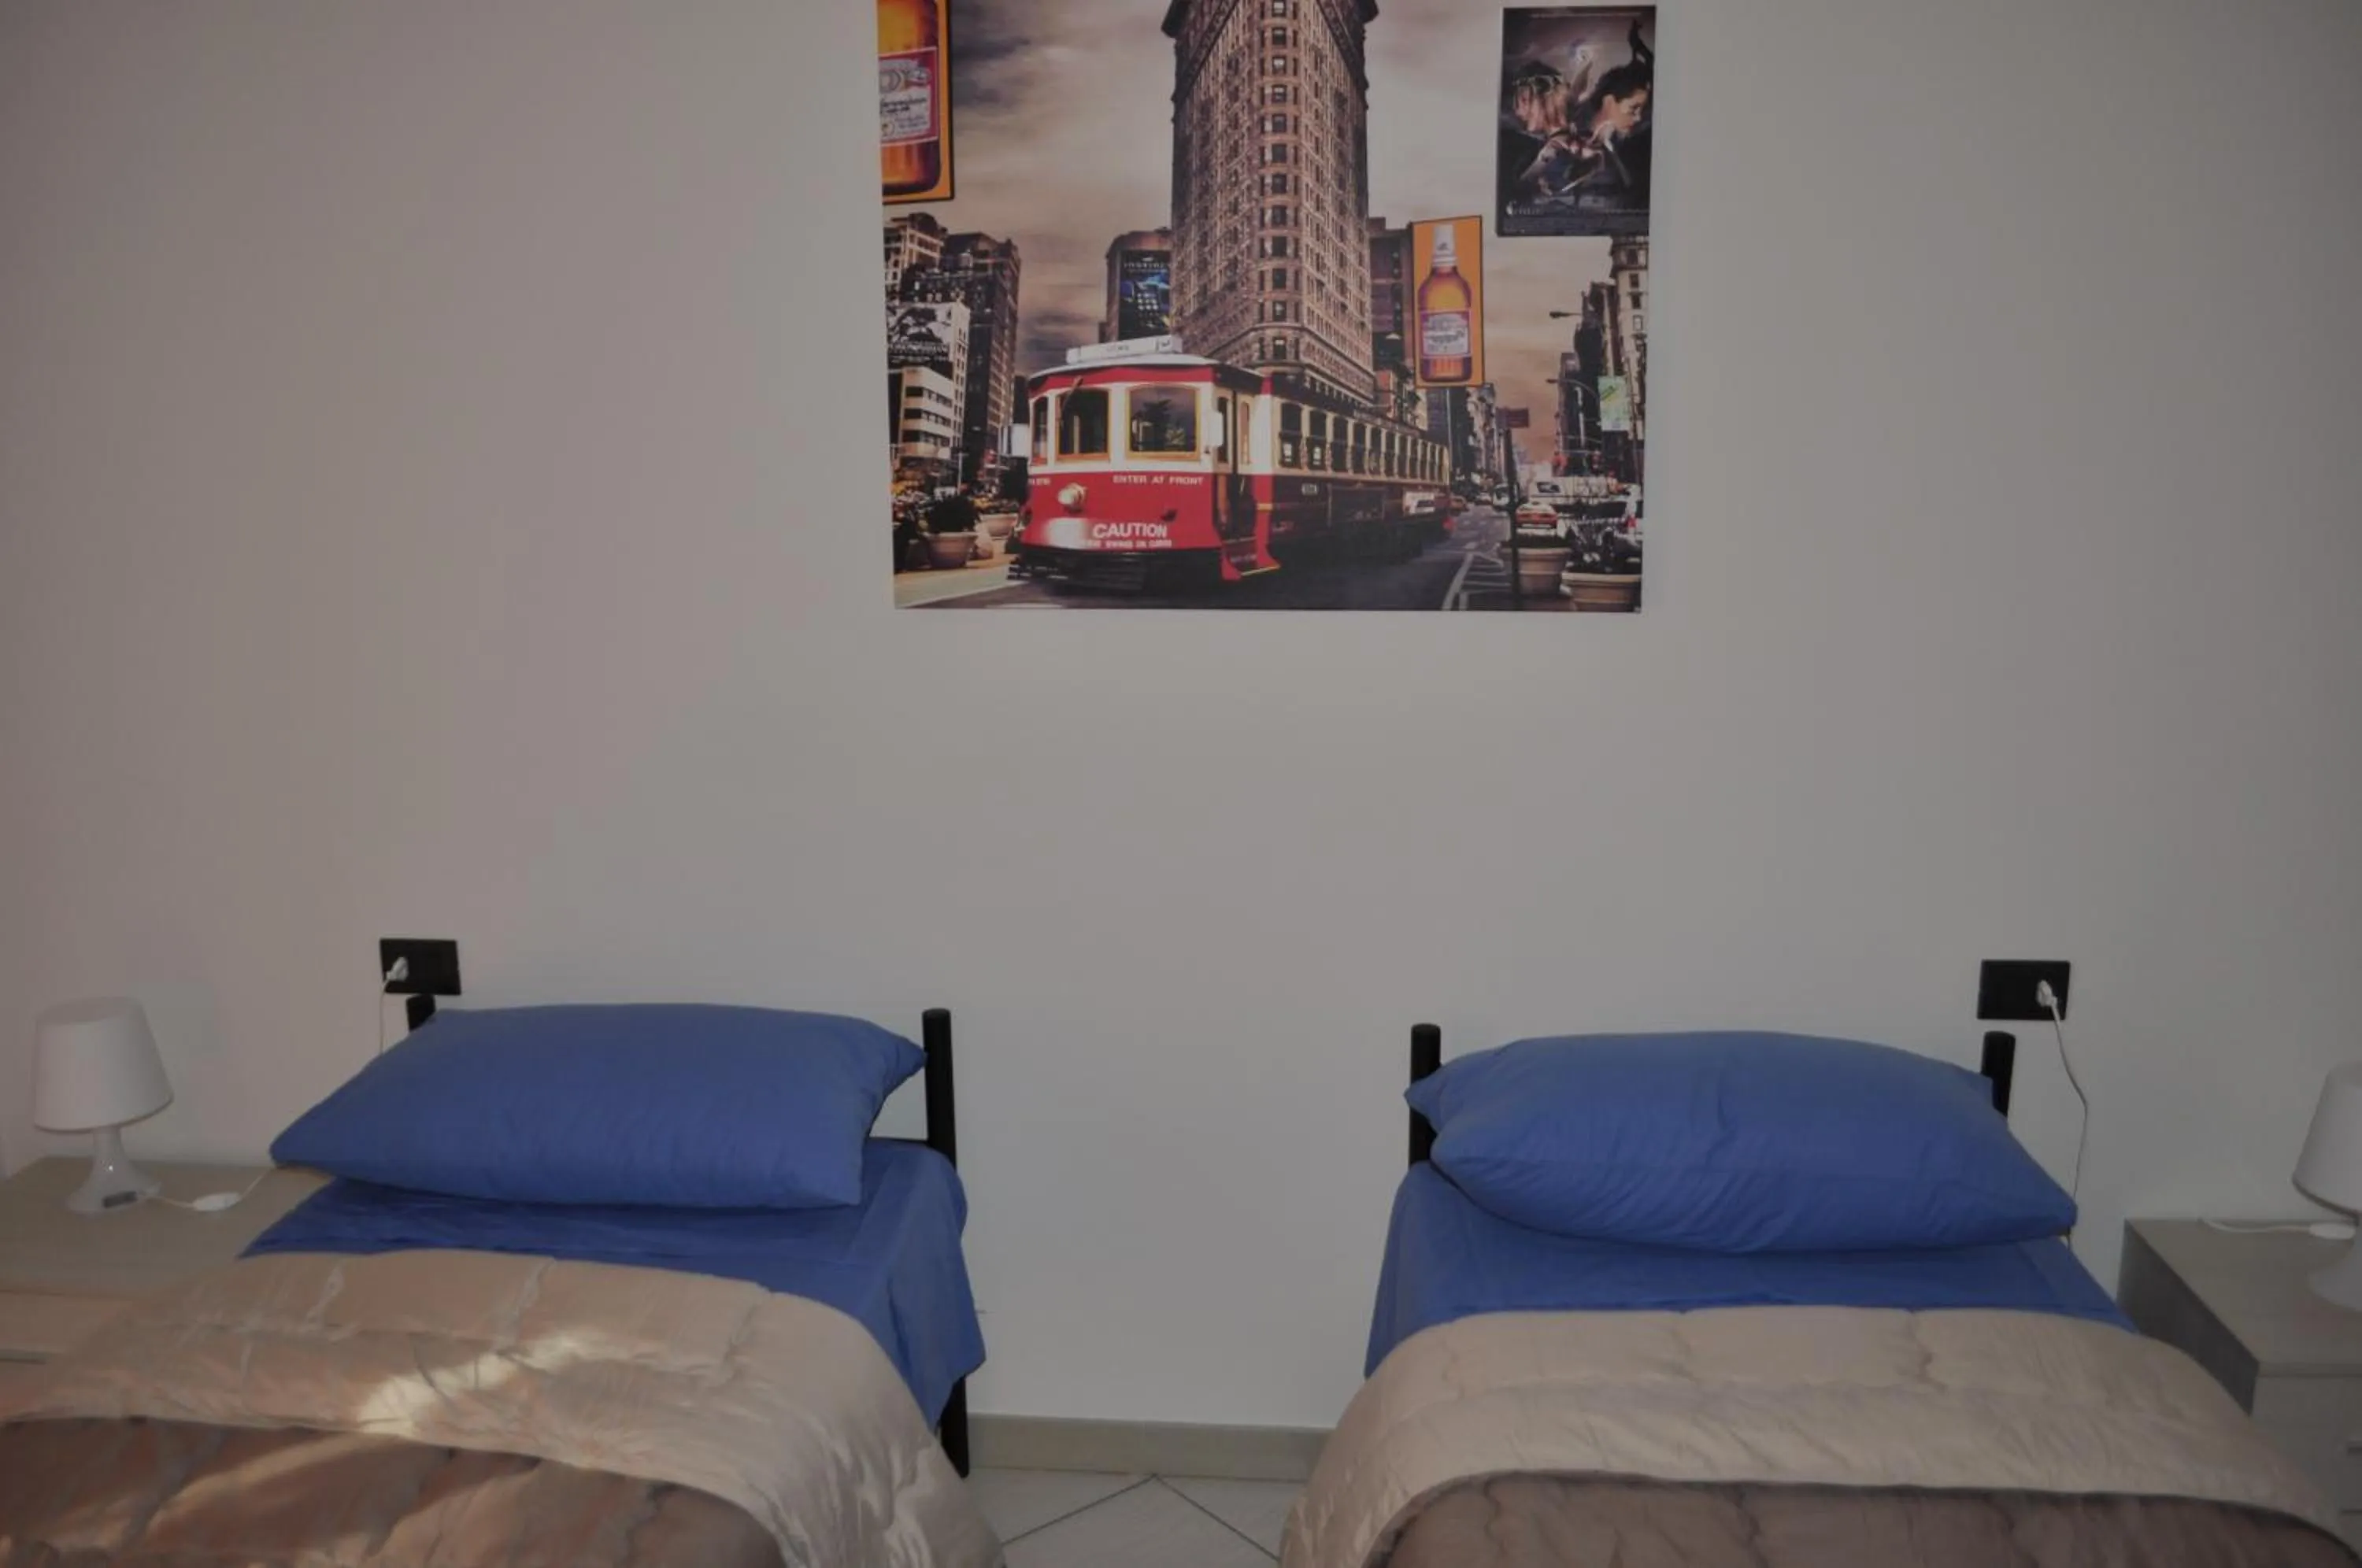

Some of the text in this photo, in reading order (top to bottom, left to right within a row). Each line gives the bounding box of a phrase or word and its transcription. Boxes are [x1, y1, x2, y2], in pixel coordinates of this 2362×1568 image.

[1113, 475, 1204, 486] ENTER AT FRONT
[1092, 522, 1168, 539] CAUTION
